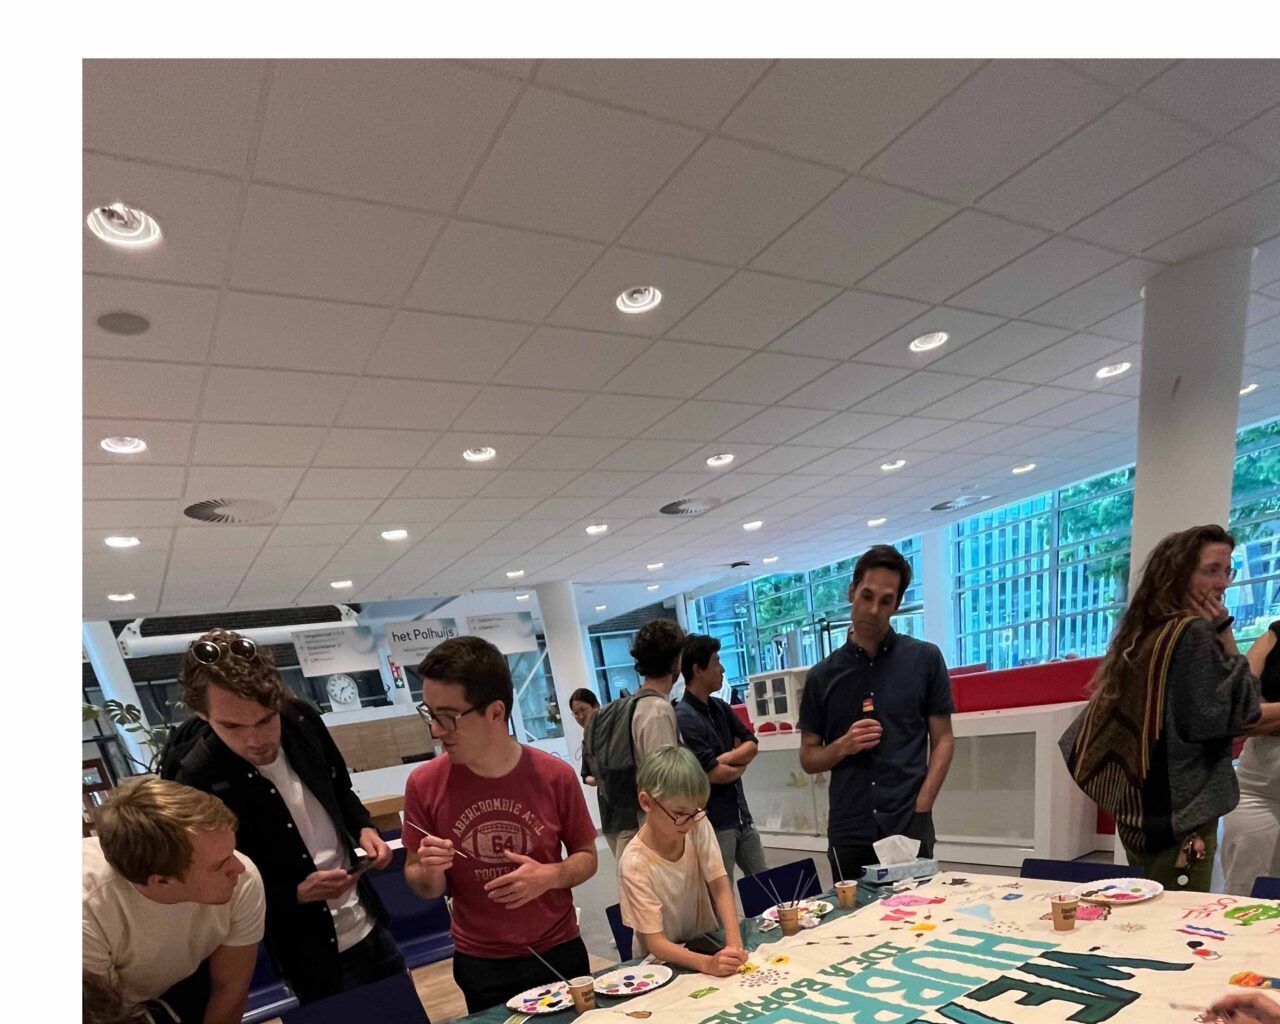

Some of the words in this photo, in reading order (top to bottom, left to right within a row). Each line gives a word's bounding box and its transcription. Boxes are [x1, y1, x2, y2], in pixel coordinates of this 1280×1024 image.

[392, 630, 413, 643] het
[452, 798, 522, 838] ABERCROMBIE
[816, 940, 916, 979] IDEA
